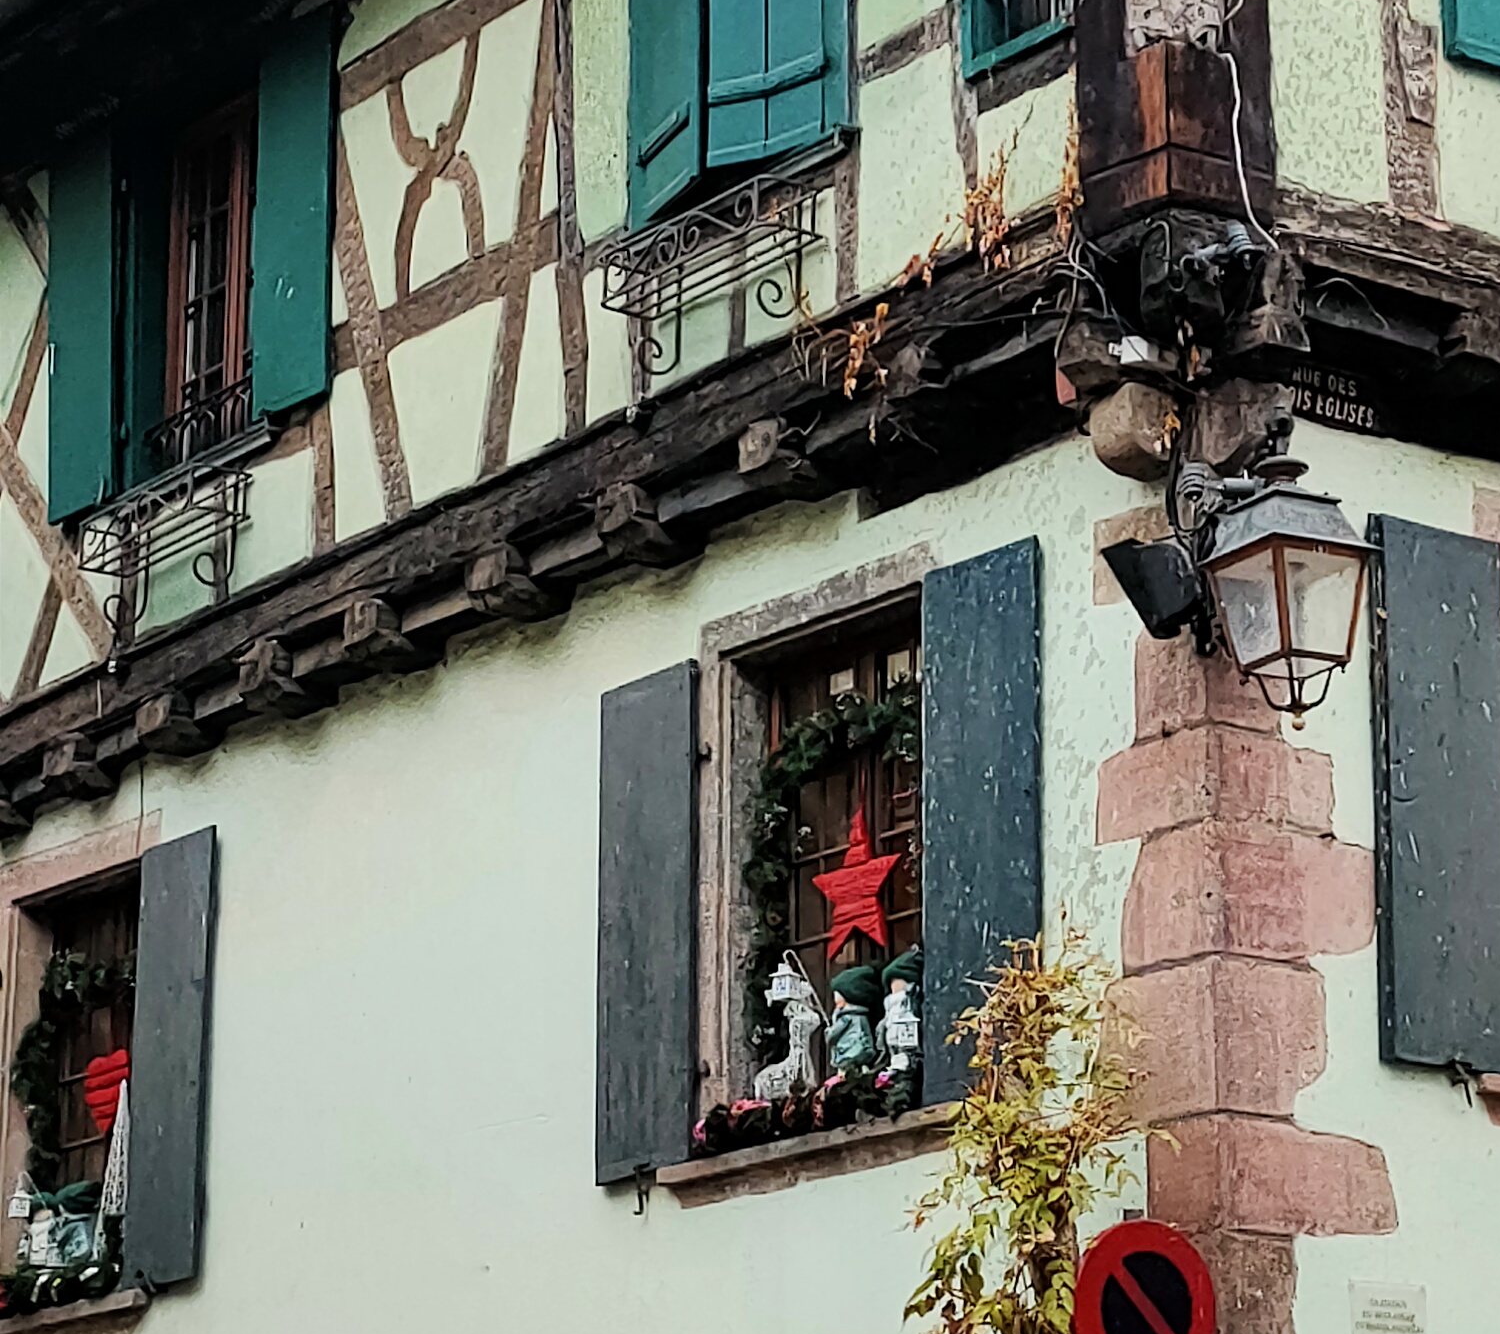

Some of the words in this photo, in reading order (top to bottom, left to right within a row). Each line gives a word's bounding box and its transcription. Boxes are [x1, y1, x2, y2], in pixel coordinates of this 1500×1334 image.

[1292, 366, 1321, 387] RUE
[1328, 374, 1357, 397] DES
[1316, 394, 1374, 428] EGLISES
